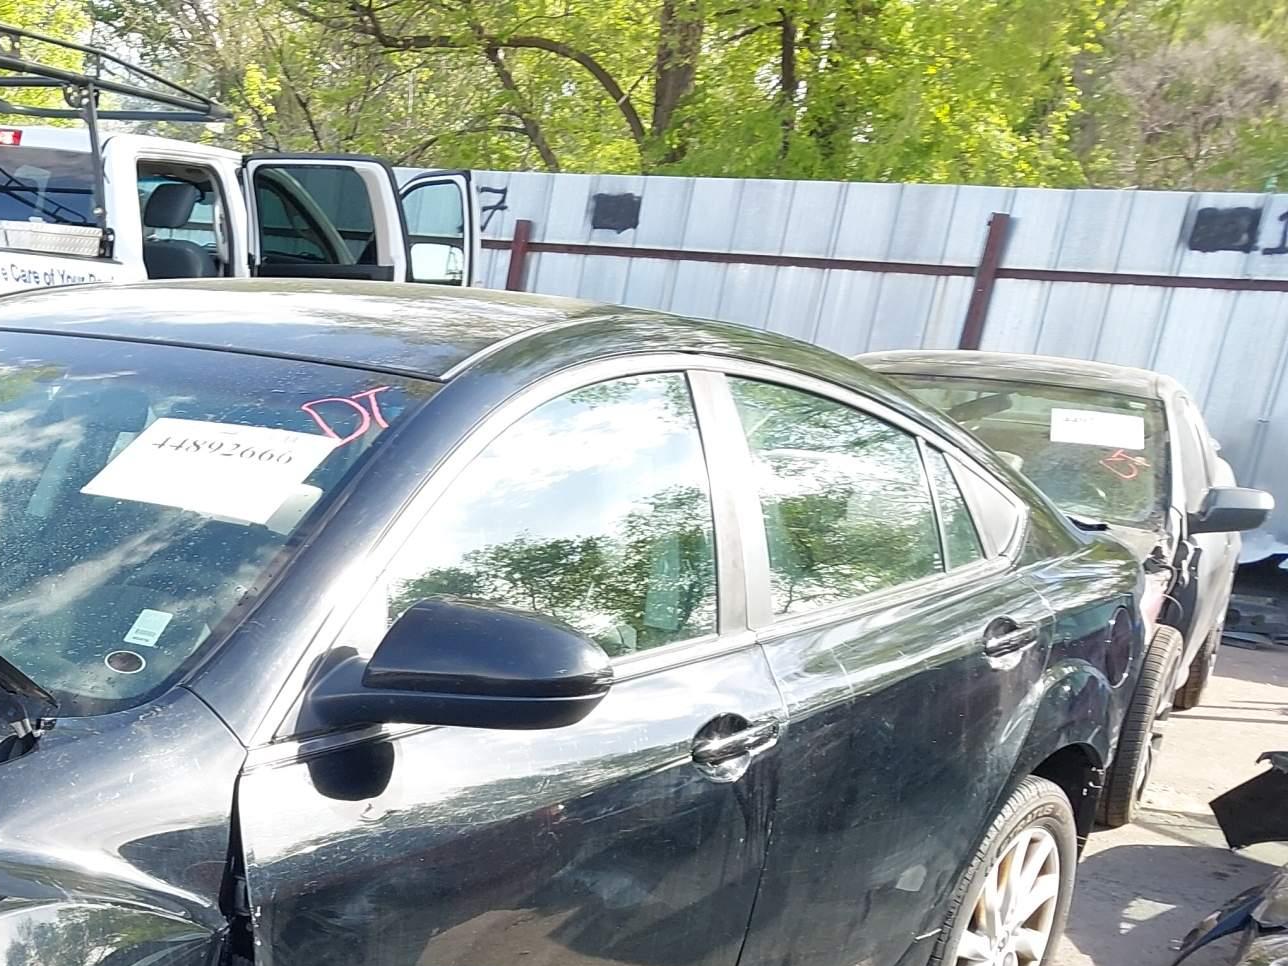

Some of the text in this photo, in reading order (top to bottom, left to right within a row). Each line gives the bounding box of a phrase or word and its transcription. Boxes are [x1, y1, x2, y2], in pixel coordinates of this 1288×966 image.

[10, 263, 41, 285] Care
[43, 267, 55, 286] of
[151, 435, 294, 465] 44892666
